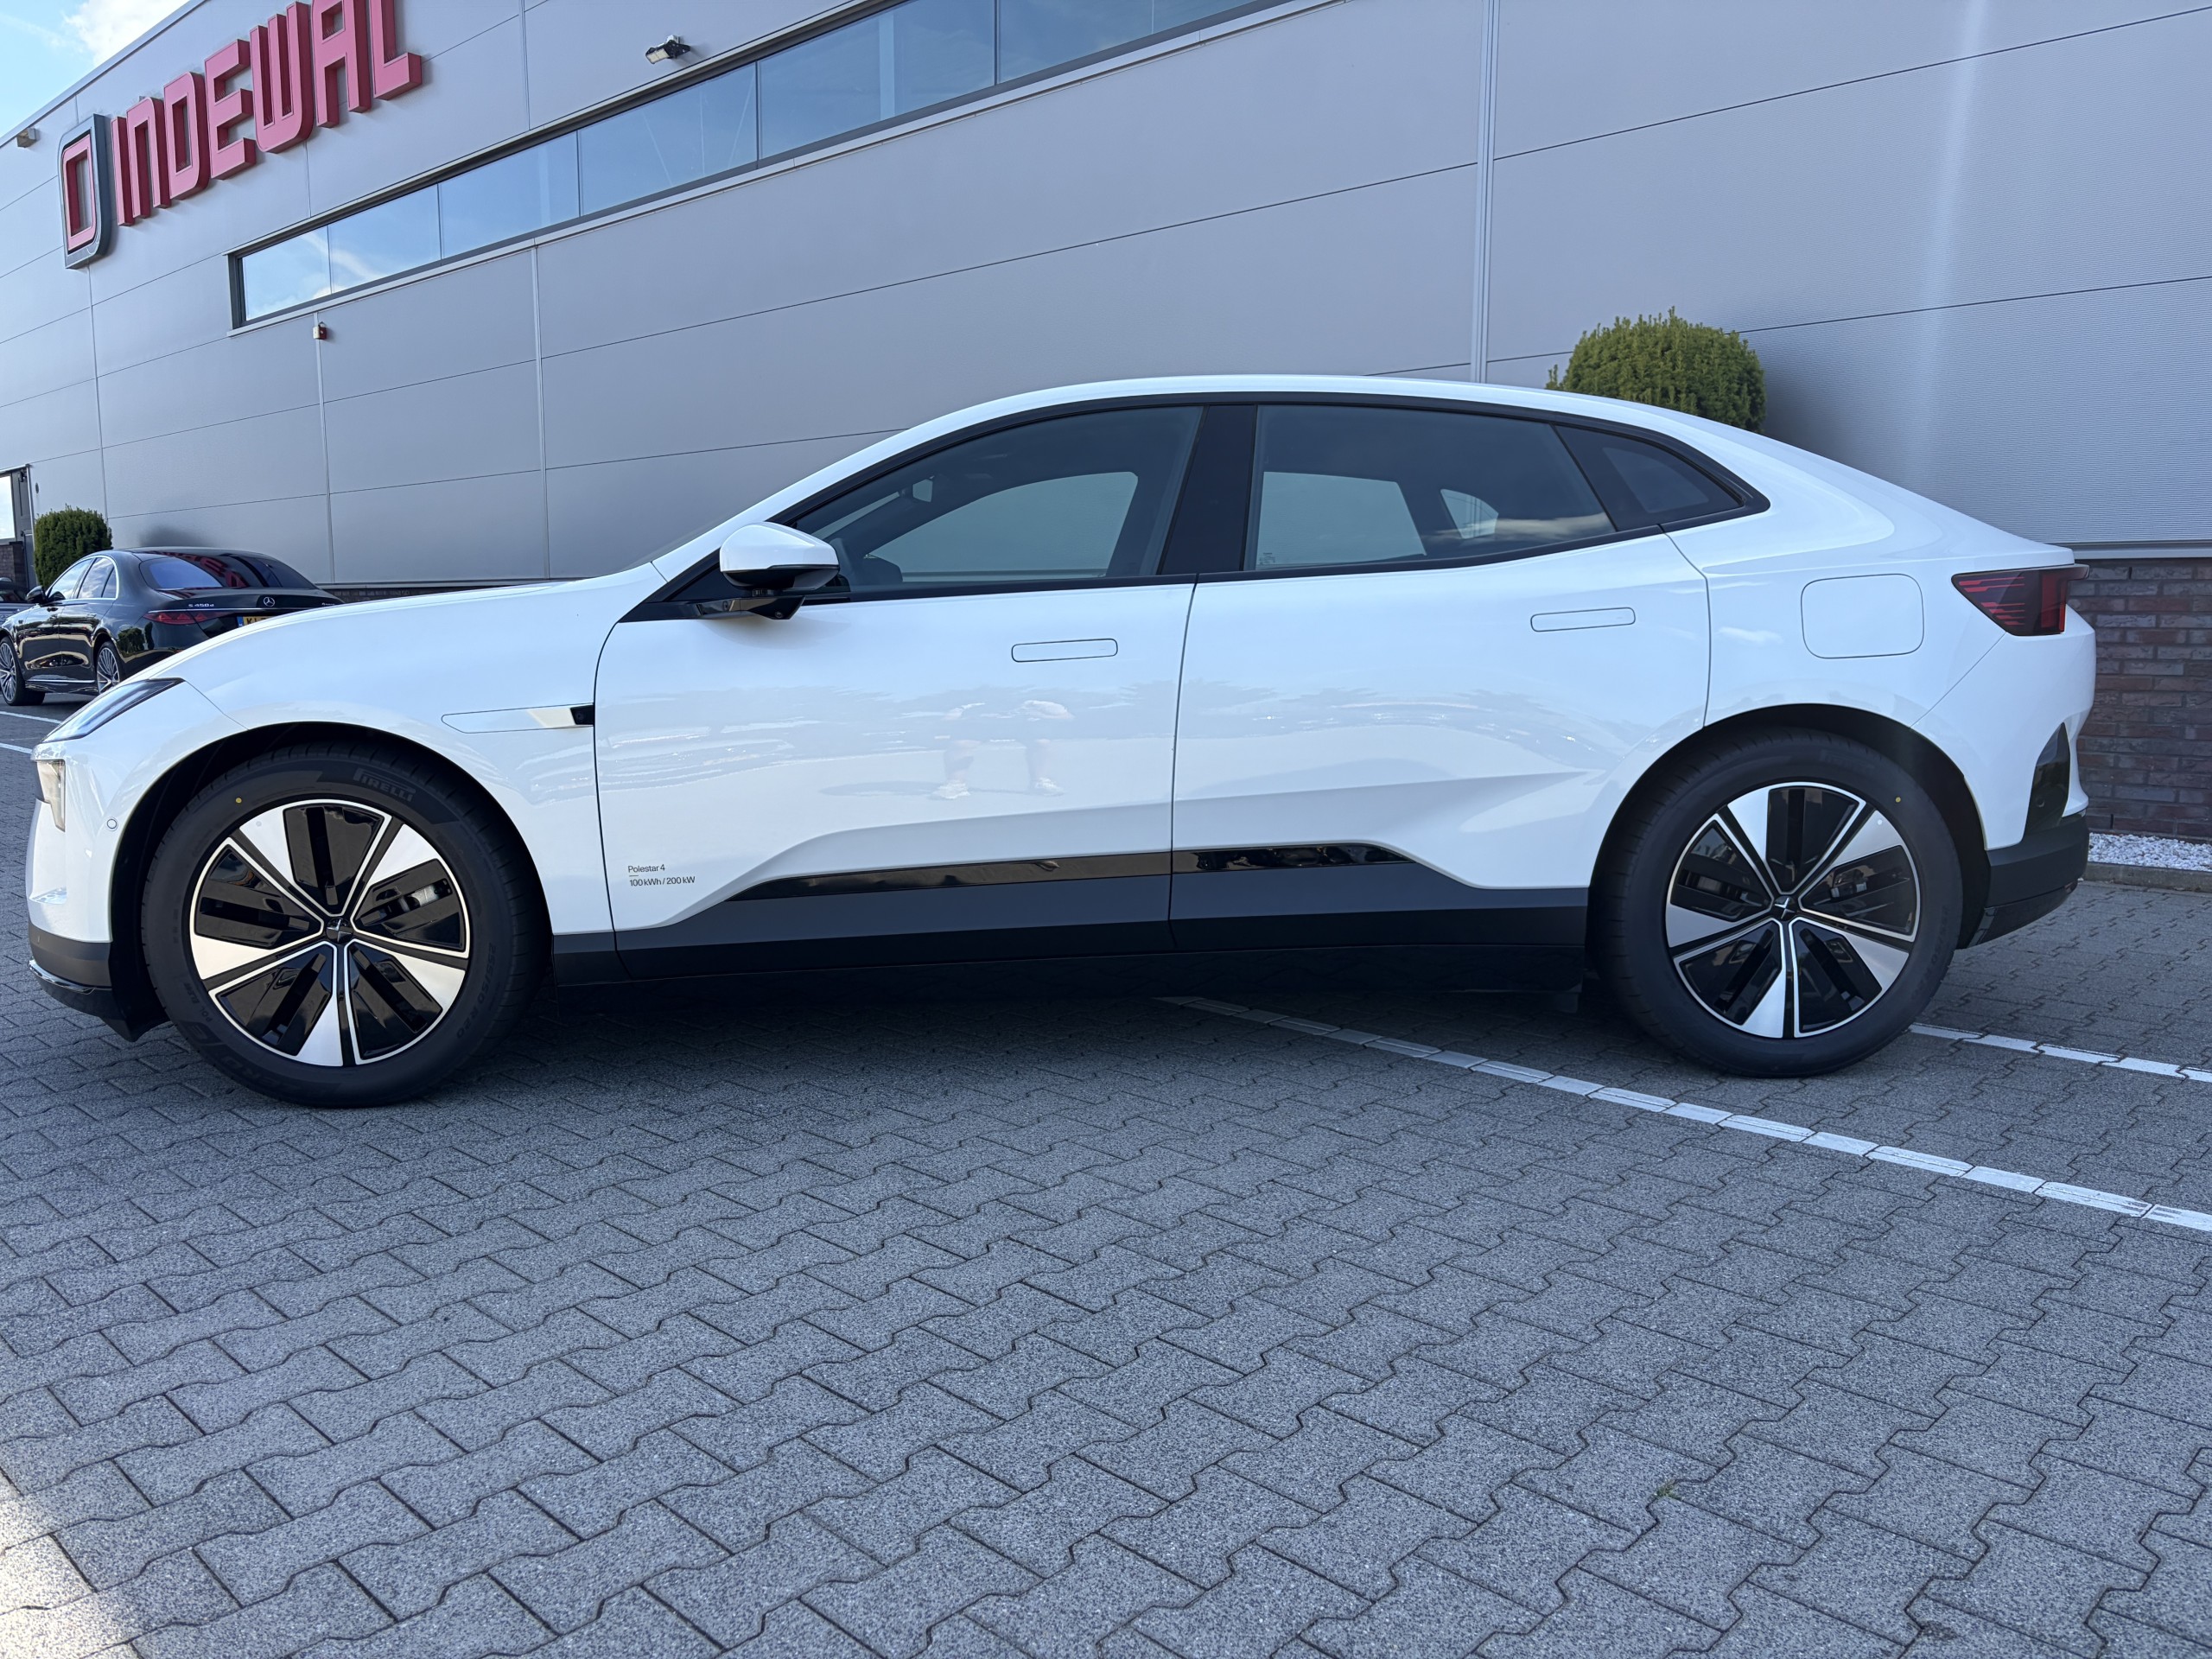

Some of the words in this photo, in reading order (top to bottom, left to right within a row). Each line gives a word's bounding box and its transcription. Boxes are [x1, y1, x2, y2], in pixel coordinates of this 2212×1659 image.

[110, 0, 423, 227] INDEWAL
[353, 767, 416, 802] PIRELLI
[660, 863, 665, 872] 4
[683, 875, 696, 884] kW
